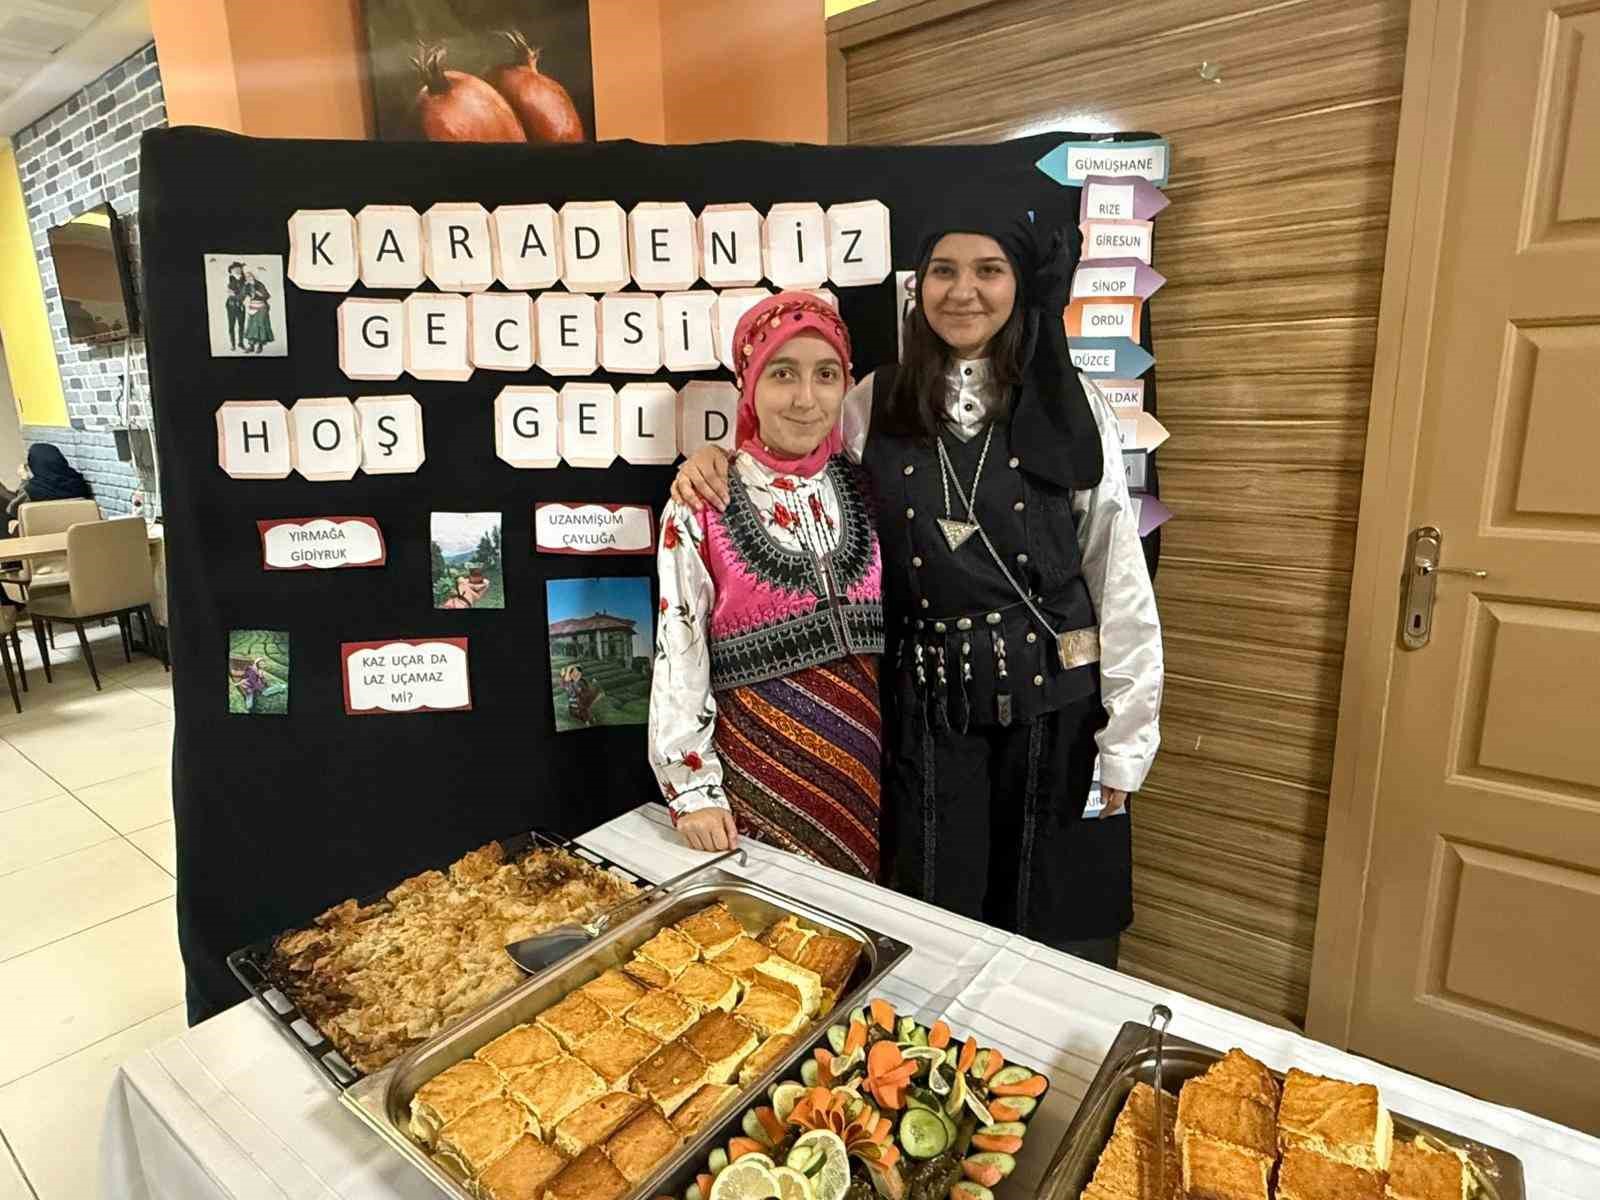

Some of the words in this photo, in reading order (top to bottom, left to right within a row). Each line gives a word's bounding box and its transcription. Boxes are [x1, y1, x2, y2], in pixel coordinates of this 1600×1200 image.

[1075, 157, 1153, 173] GÜMÜŞHANE
[310, 221, 863, 266] KARADENİZ
[1096, 233, 1141, 247] GİRESUN
[1092, 279, 1127, 292] SİNOP
[1091, 315, 1124, 326] ORDU
[361, 311, 690, 352] GECESİ
[1074, 354, 1110, 366] DÜZCE
[241, 415, 399, 456] HOŞ
[512, 403, 729, 441] GELD
[288, 527, 346, 542] YIRMAĞA
[291, 548, 347, 561] GİDİYRUK
[362, 656, 385, 667] KAZ
[391, 654, 424, 667] UÇAR
[430, 653, 448, 664] DA
[363, 674, 385, 686] LAZ
[391, 671, 444, 686] UÇAMAZ
[391, 690, 414, 703] Mİ?
